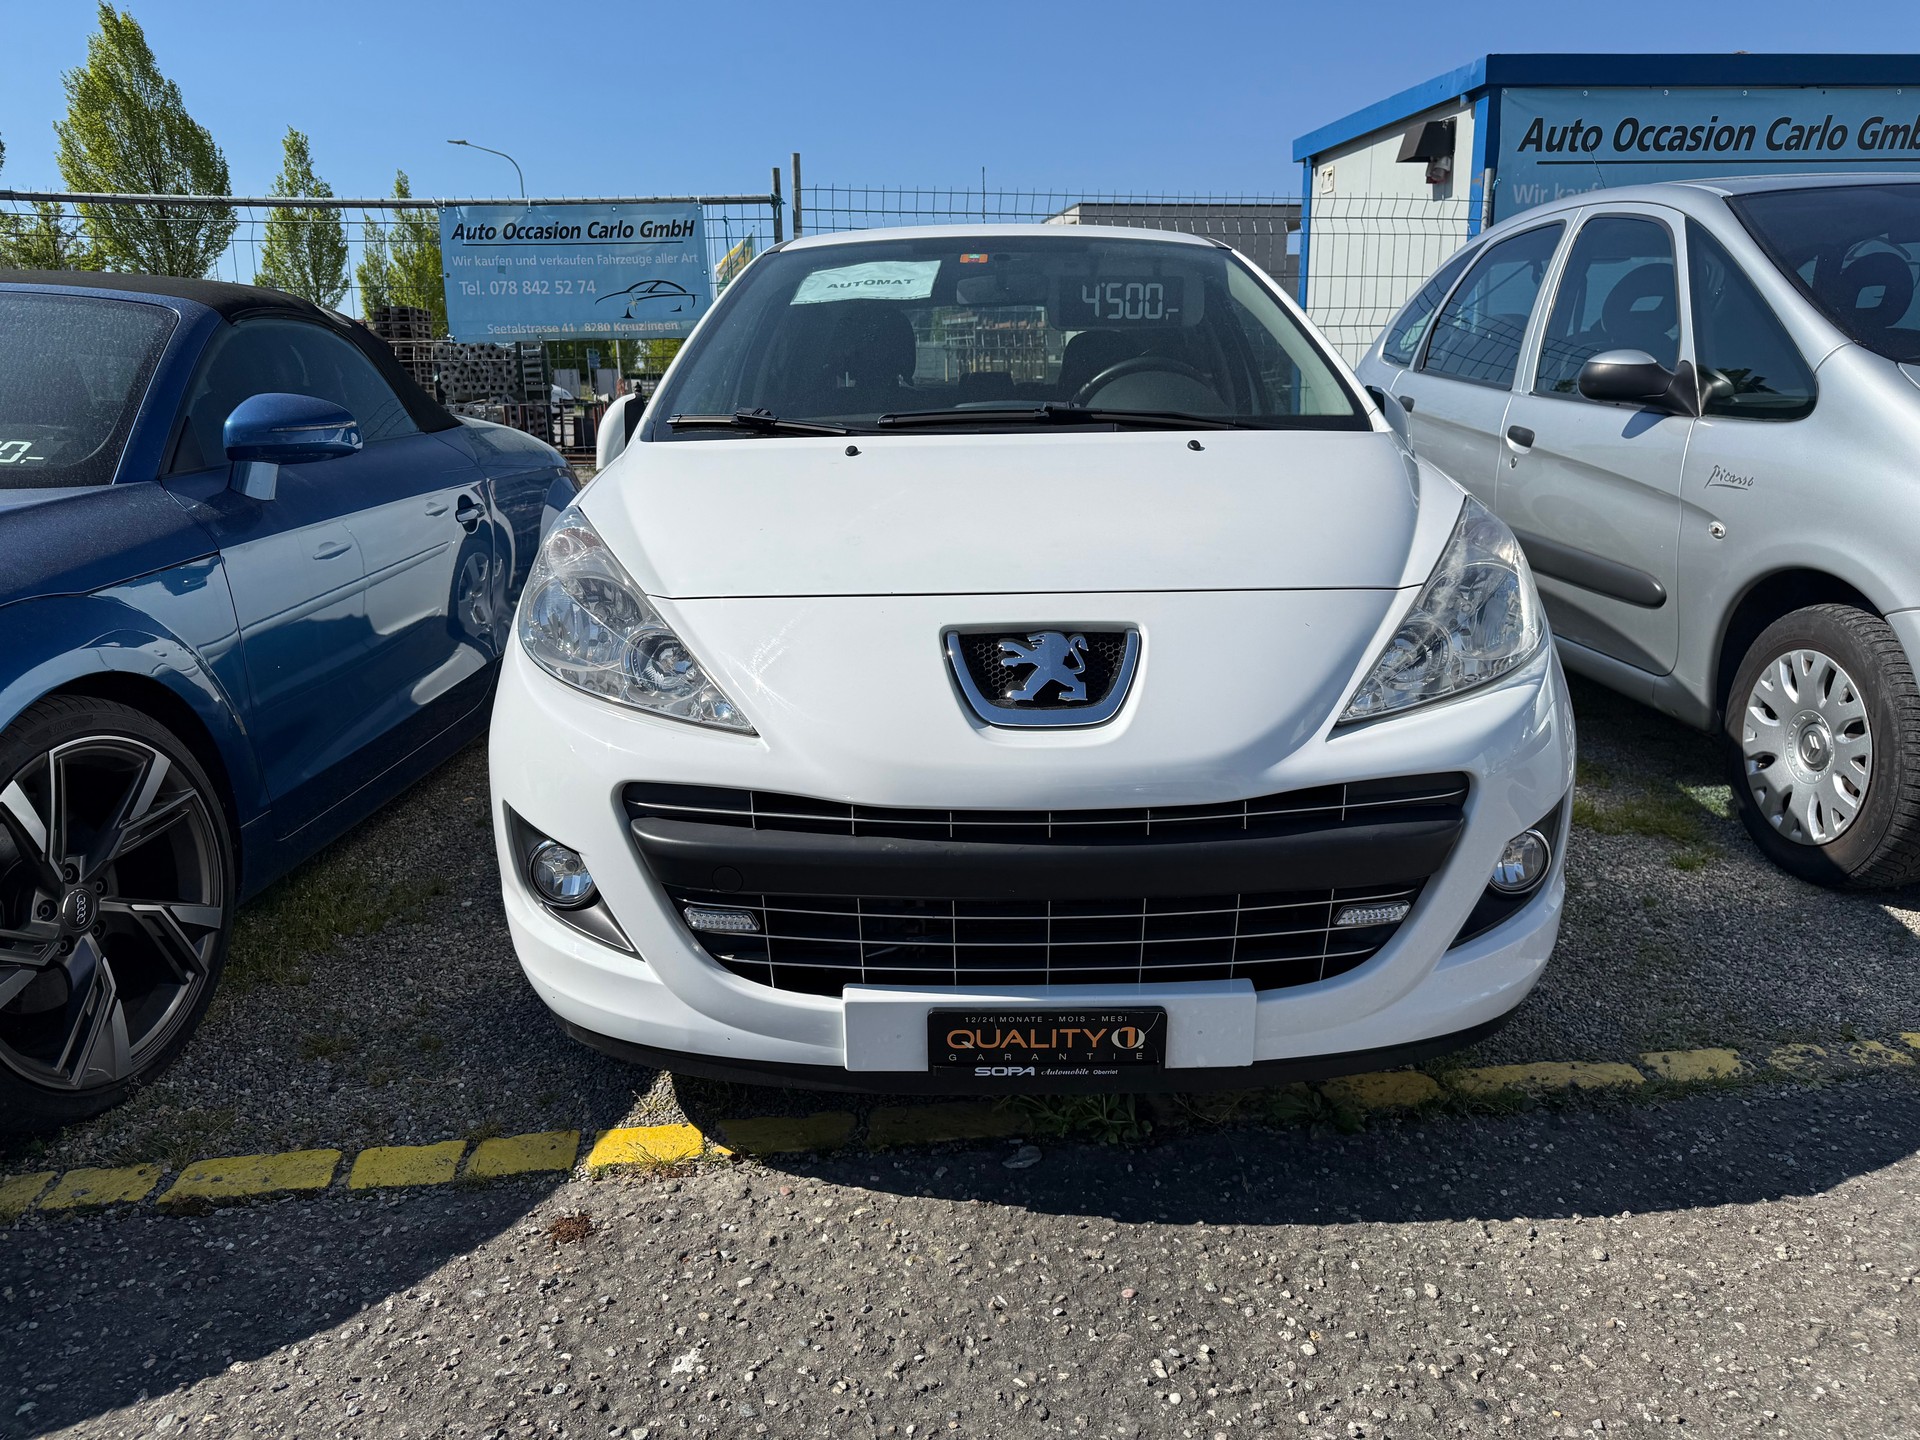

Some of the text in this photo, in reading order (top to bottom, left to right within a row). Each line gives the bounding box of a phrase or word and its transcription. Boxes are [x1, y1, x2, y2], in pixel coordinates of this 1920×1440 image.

[1517, 117, 1603, 153] Auto
[1612, 115, 1757, 153] Occasion
[1765, 114, 1848, 151] Carlo
[1513, 184, 1548, 204] Wir
[451, 219, 695, 240] Auto Occasion Carlo GmbH
[452, 252, 699, 267] Wir kaufen und verkaufen Fahrzeuge aller Art
[459, 279, 597, 296] Tel. 078 842 52 74
[827, 279, 915, 288] AUTOMAT
[487, 321, 679, 335] Seetalstrasse 41 8280 Kreuzlingen
[1704, 465, 1754, 488] Picasso
[1058, 1015, 1086, 1023] MOIS
[946, 1028, 1107, 1049] QUALITY
[948, 1053, 1143, 1062] GARANTIE
[974, 1066, 1036, 1076] SOPA
[1040, 1068, 1089, 1076] Automobile
